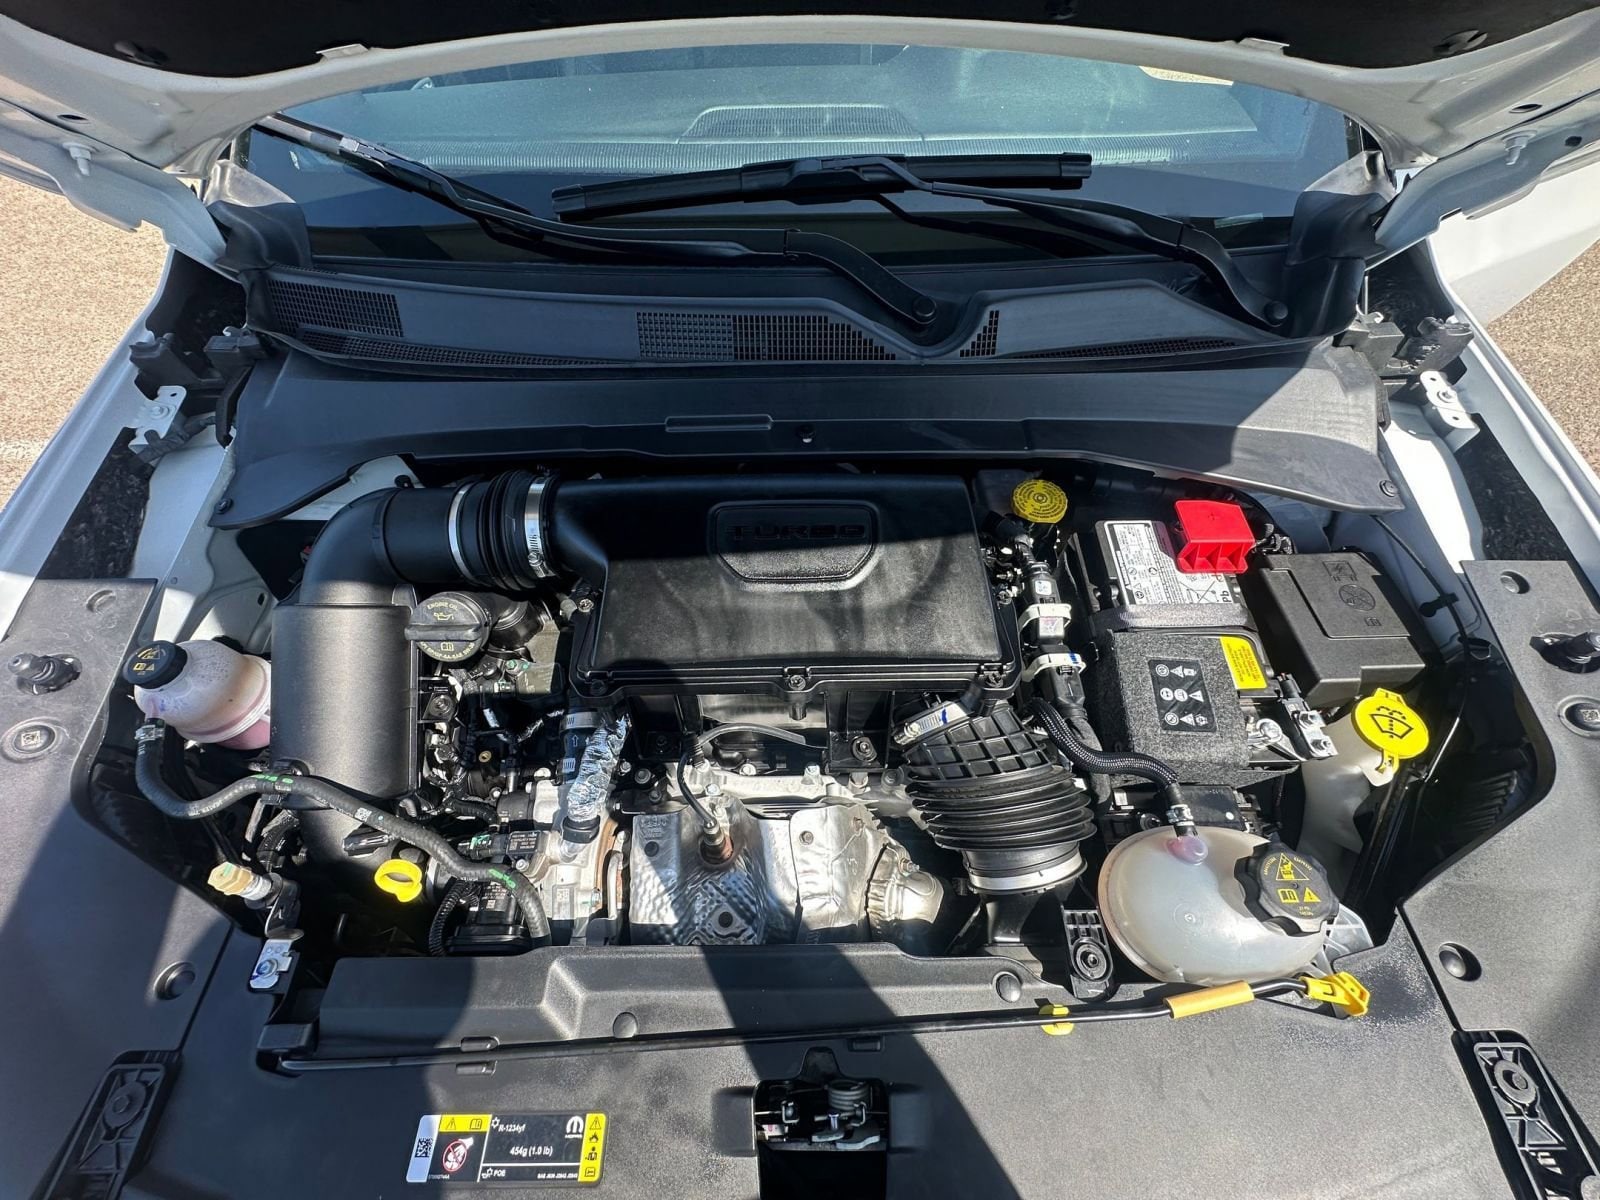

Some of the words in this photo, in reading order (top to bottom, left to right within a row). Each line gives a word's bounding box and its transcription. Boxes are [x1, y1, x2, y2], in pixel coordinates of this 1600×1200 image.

[498, 1124, 526, 1134] R-1234yf
[509, 1146, 528, 1157] 454g
[529, 1146, 543, 1157] (1.0
[543, 1146, 553, 1157] lb)
